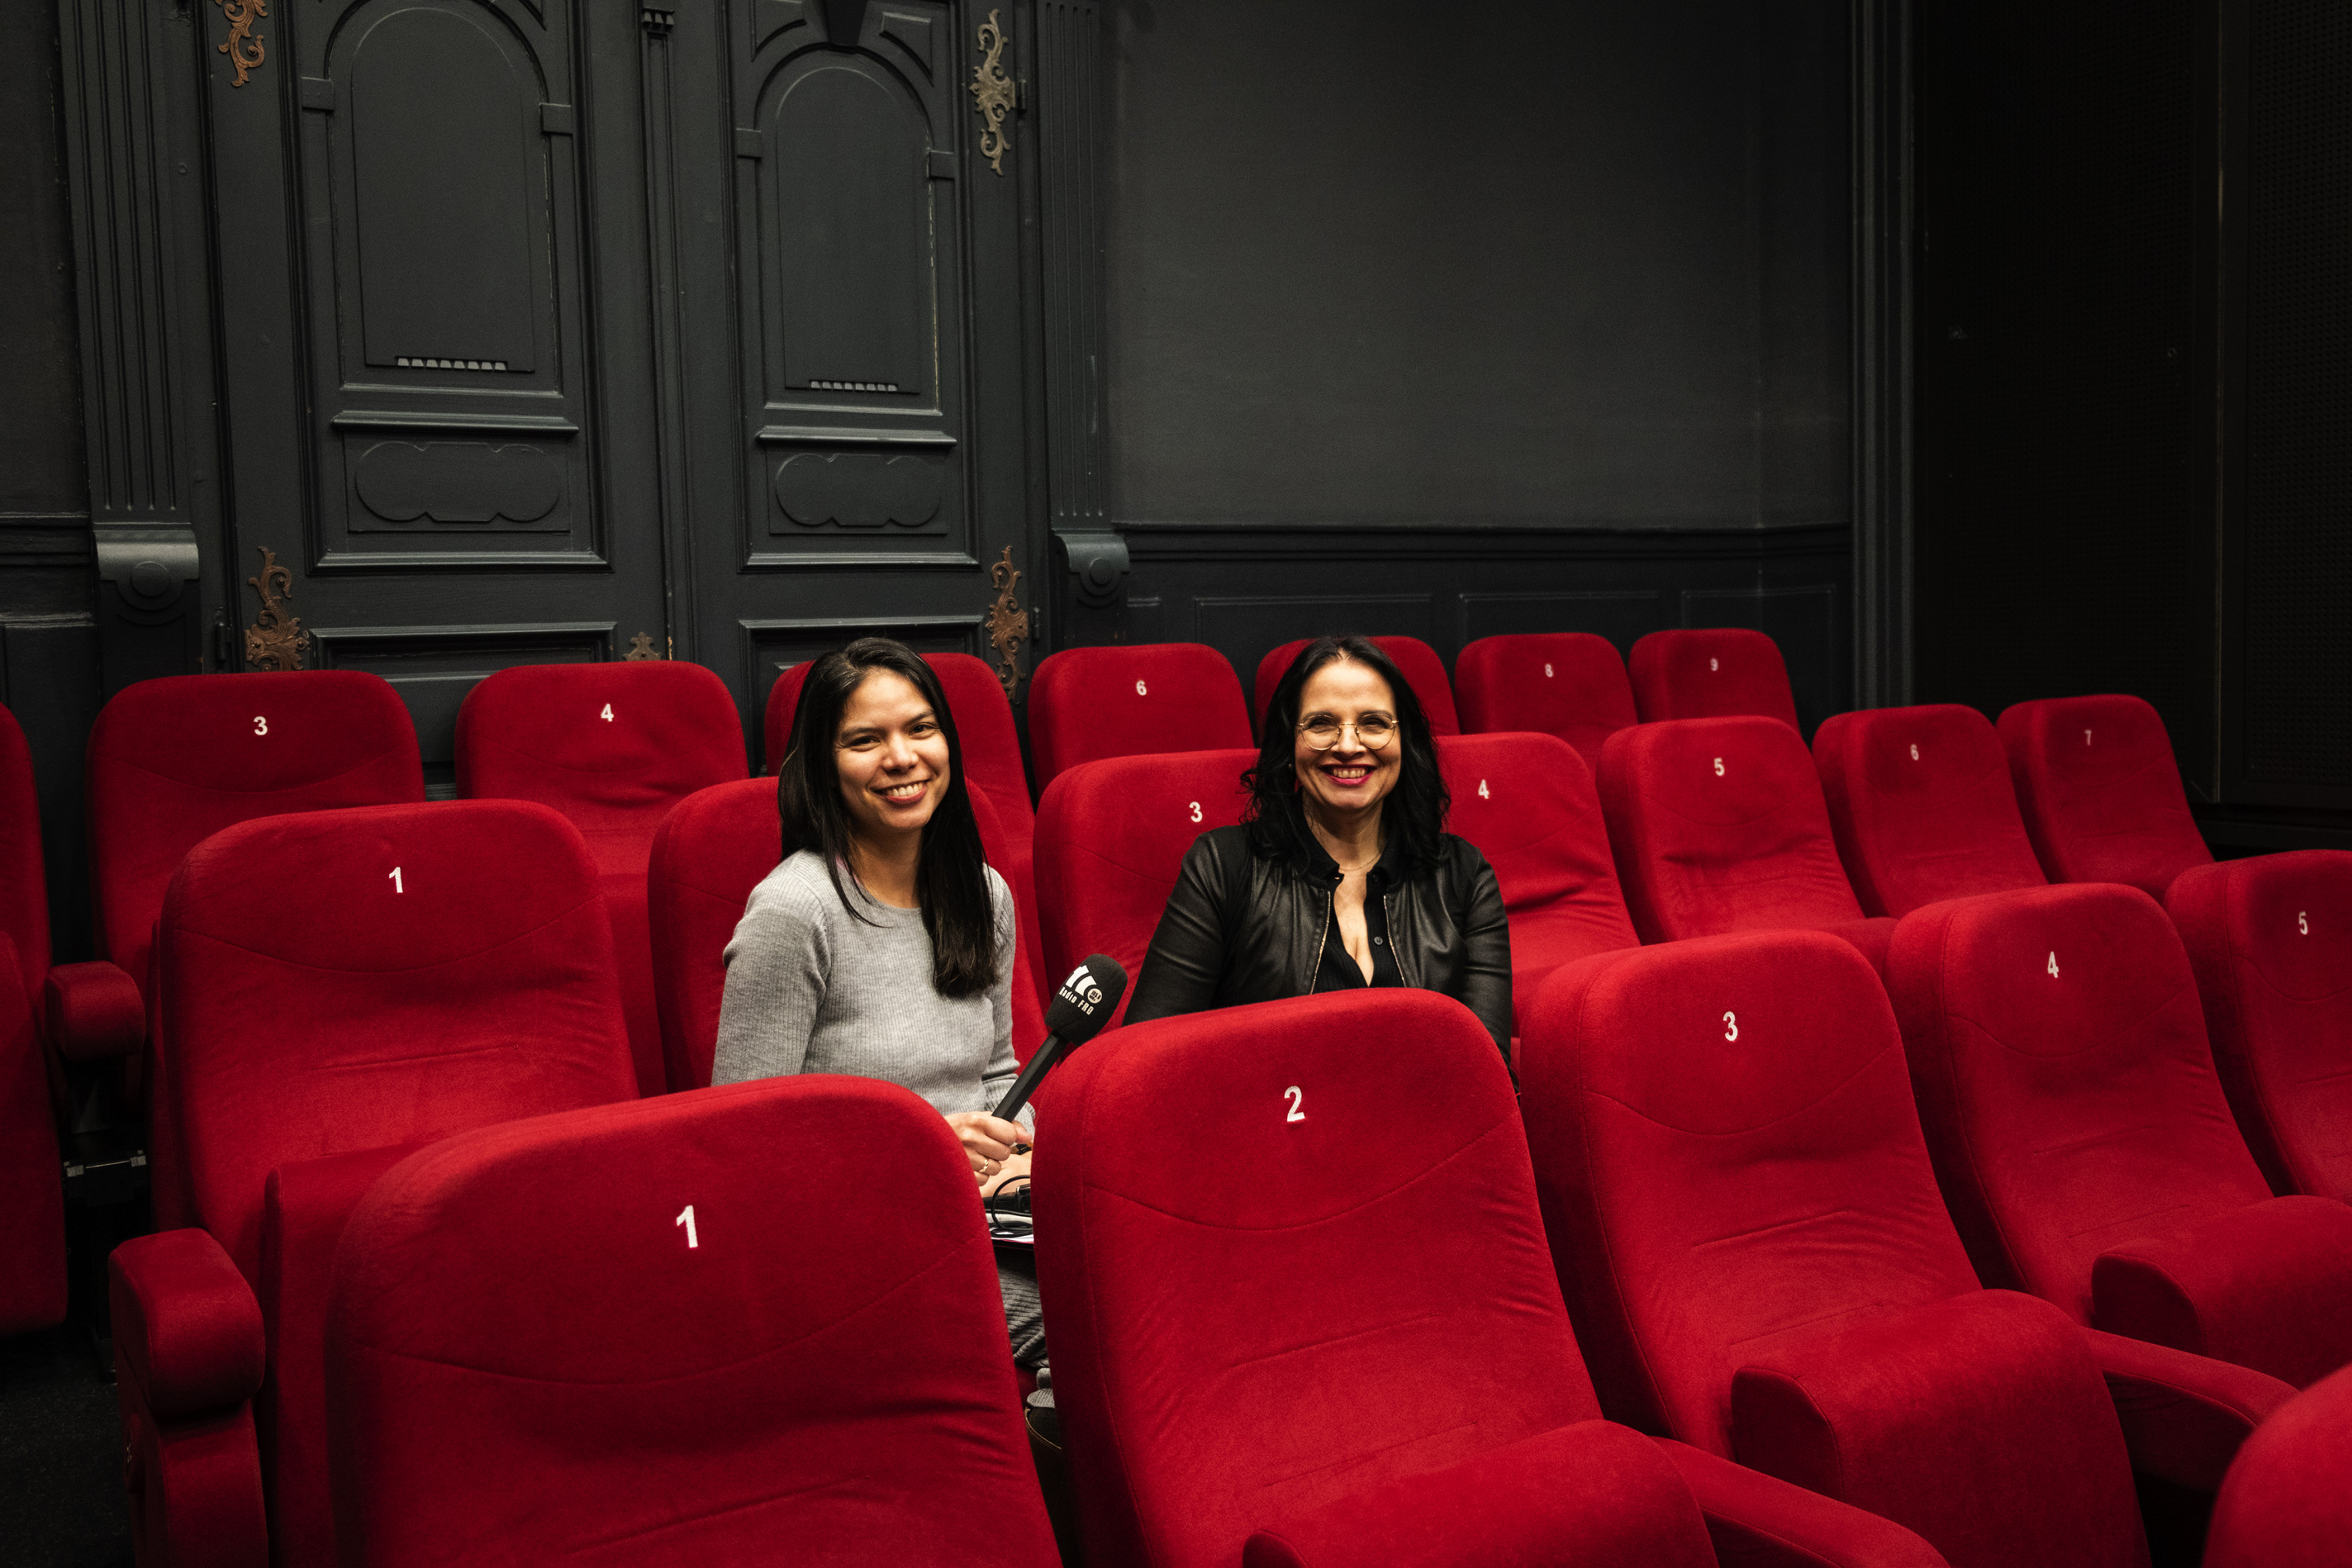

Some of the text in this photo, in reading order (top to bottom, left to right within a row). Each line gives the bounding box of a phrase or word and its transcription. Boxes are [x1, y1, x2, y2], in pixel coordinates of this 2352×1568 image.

[1545, 663, 1554, 678] 8
[1710, 657, 1719, 671] 9
[1136, 680, 1147, 696] 6
[600, 703, 614, 722] 4
[254, 716, 268, 735] 3
[2084, 729, 2093, 745] 7
[1910, 744, 1920, 761] 6
[1714, 757, 1725, 776] 5
[1478, 779, 1490, 799] 4
[1189, 801, 1203, 823] 3
[388, 867, 404, 894] 1
[2298, 912, 2309, 935] 5
[2047, 951, 2060, 978] 4
[1059, 986, 1078, 1004] Radio
[1077, 999, 1094, 1015] FRO
[1722, 1011, 1739, 1042] 3
[1284, 1086, 1306, 1123] 2
[676, 1205, 698, 1249] 1
